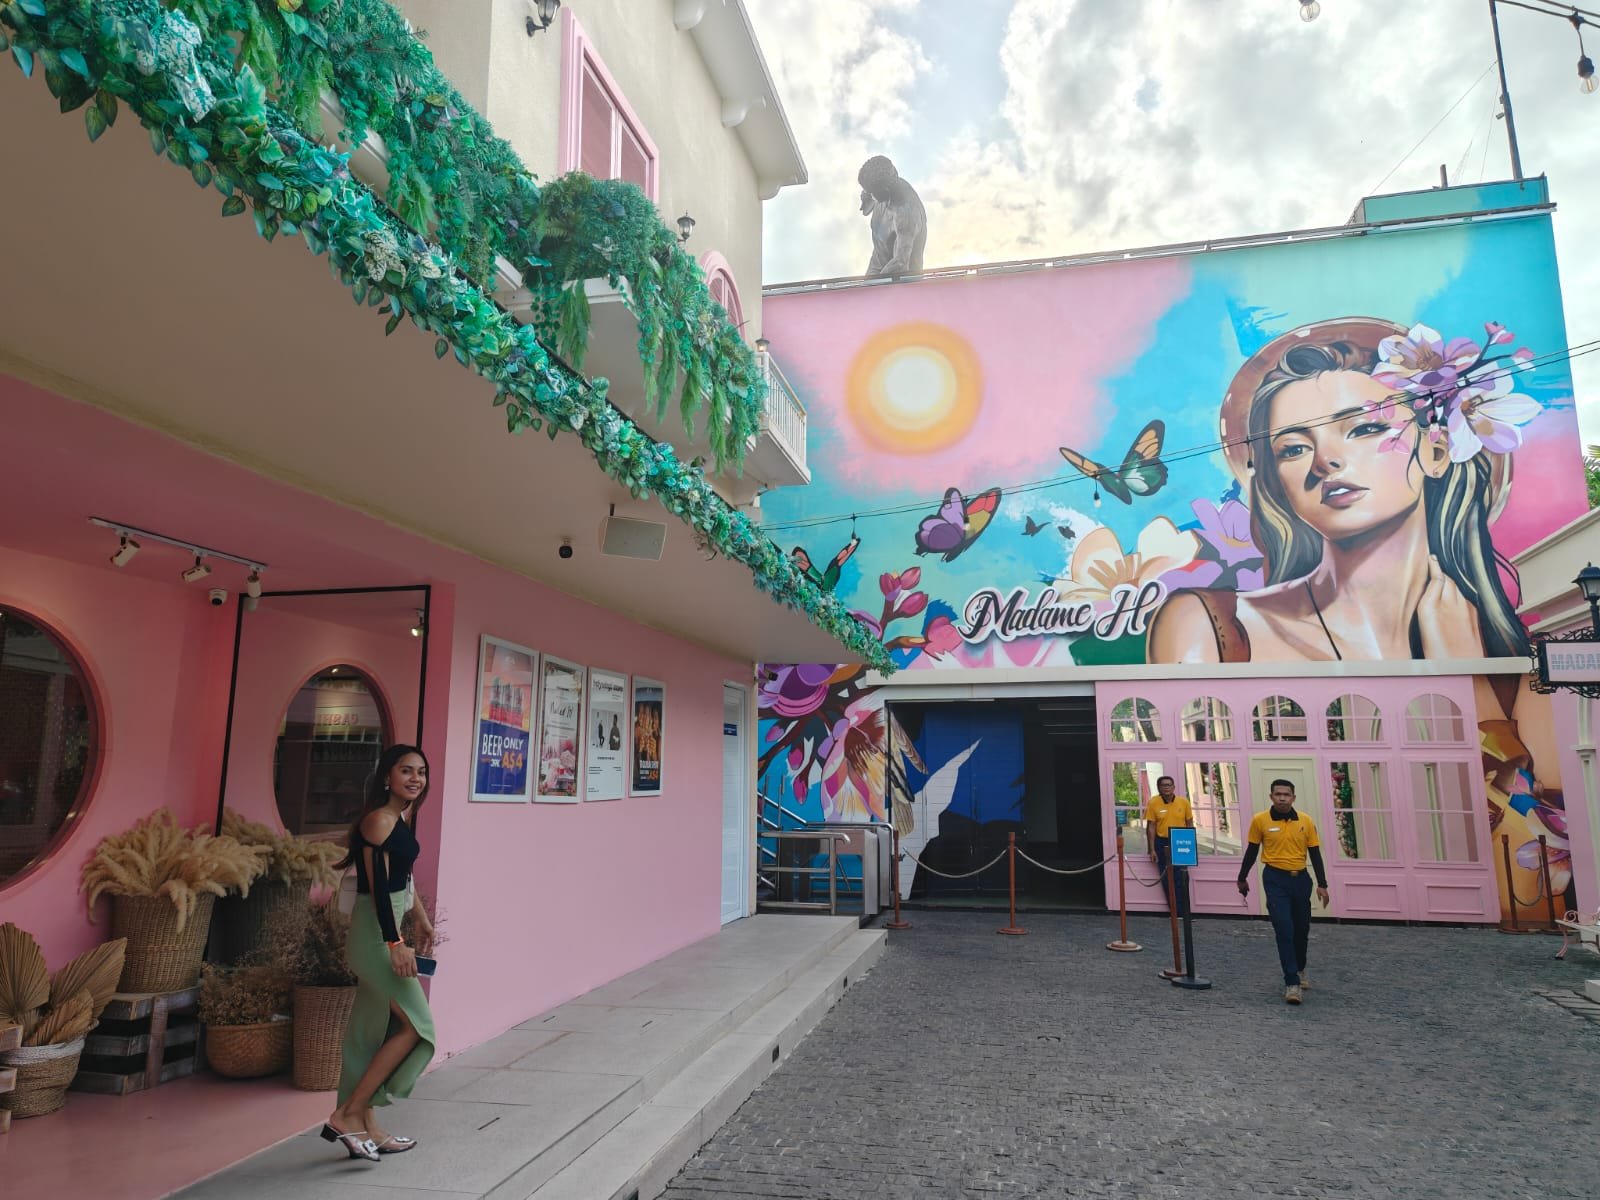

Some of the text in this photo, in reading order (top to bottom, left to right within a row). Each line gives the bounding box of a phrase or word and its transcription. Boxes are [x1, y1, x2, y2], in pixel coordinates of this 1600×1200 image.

[957, 581, 1162, 639] Madame H
[482, 733, 524, 756] BEER ONLY
